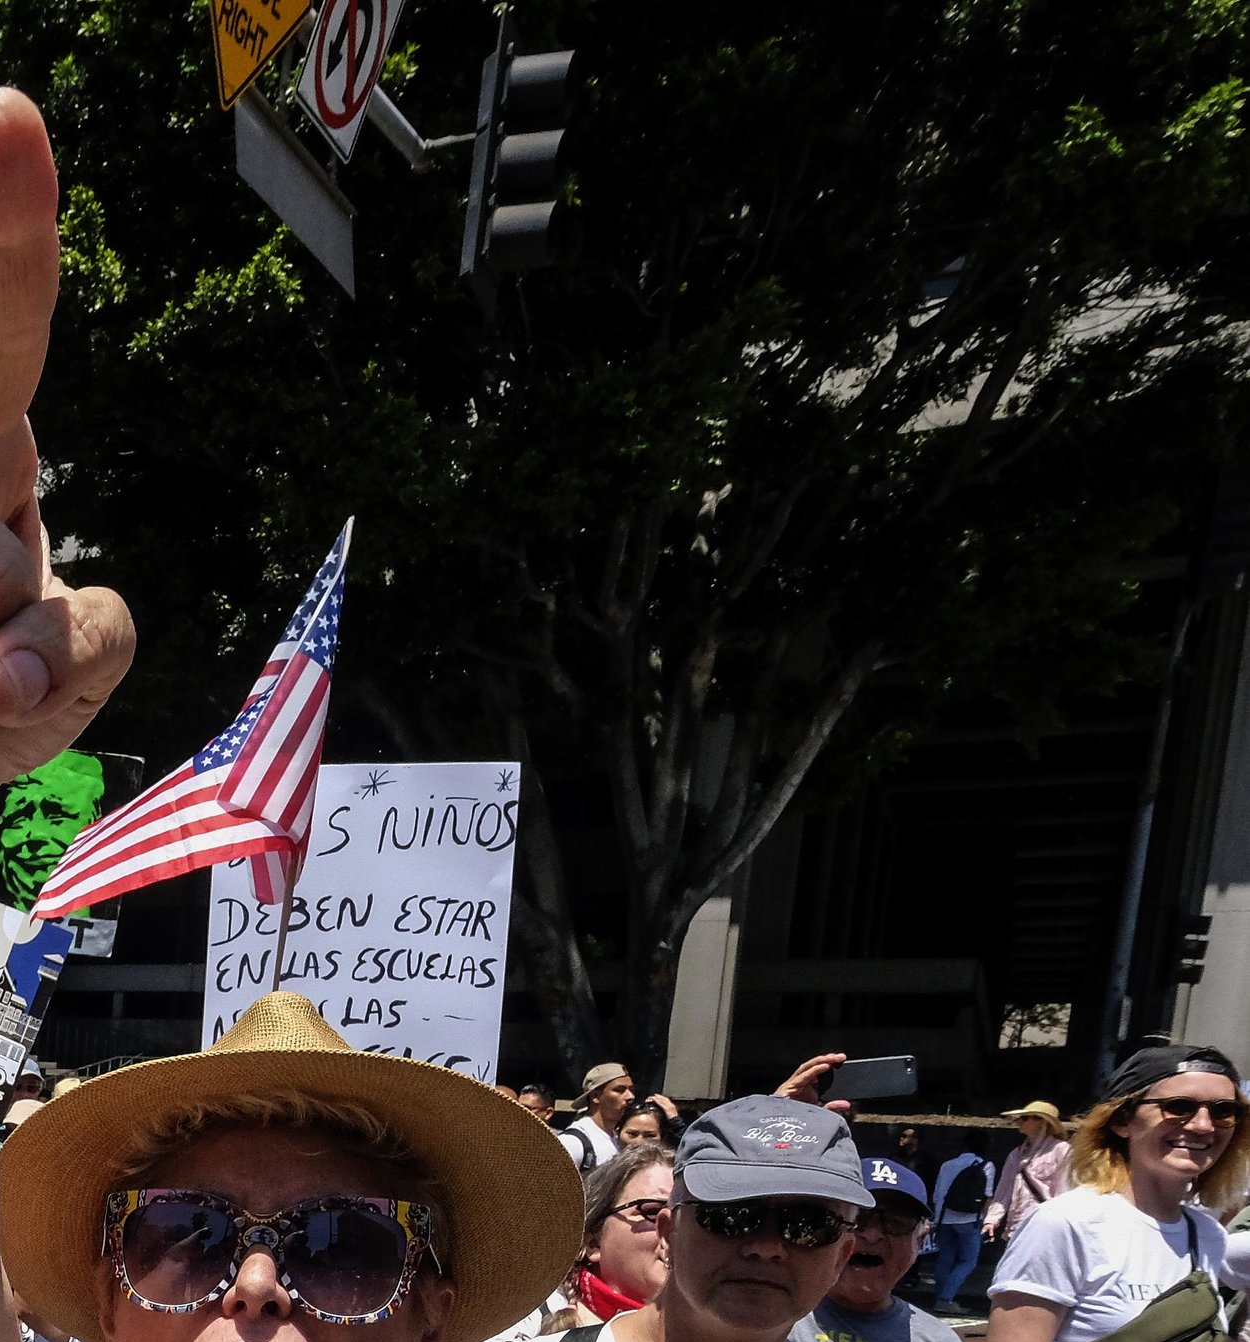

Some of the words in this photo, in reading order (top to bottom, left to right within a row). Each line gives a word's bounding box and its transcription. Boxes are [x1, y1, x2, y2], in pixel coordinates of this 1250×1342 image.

[218, 0, 269, 63] RIGHT
[378, 795, 519, 855] NIÑOS
[211, 894, 375, 946] DEBEN
[394, 895, 497, 941] ESTAR
[216, 949, 273, 993] EN
[280, 949, 343, 982] LAS
[351, 947, 499, 988] ESCUELAS
[340, 996, 408, 1029] LAS
[742, 1127, 774, 1143] Big
[777, 1130, 820, 1144] Bear
[871, 1160, 898, 1185] LA
